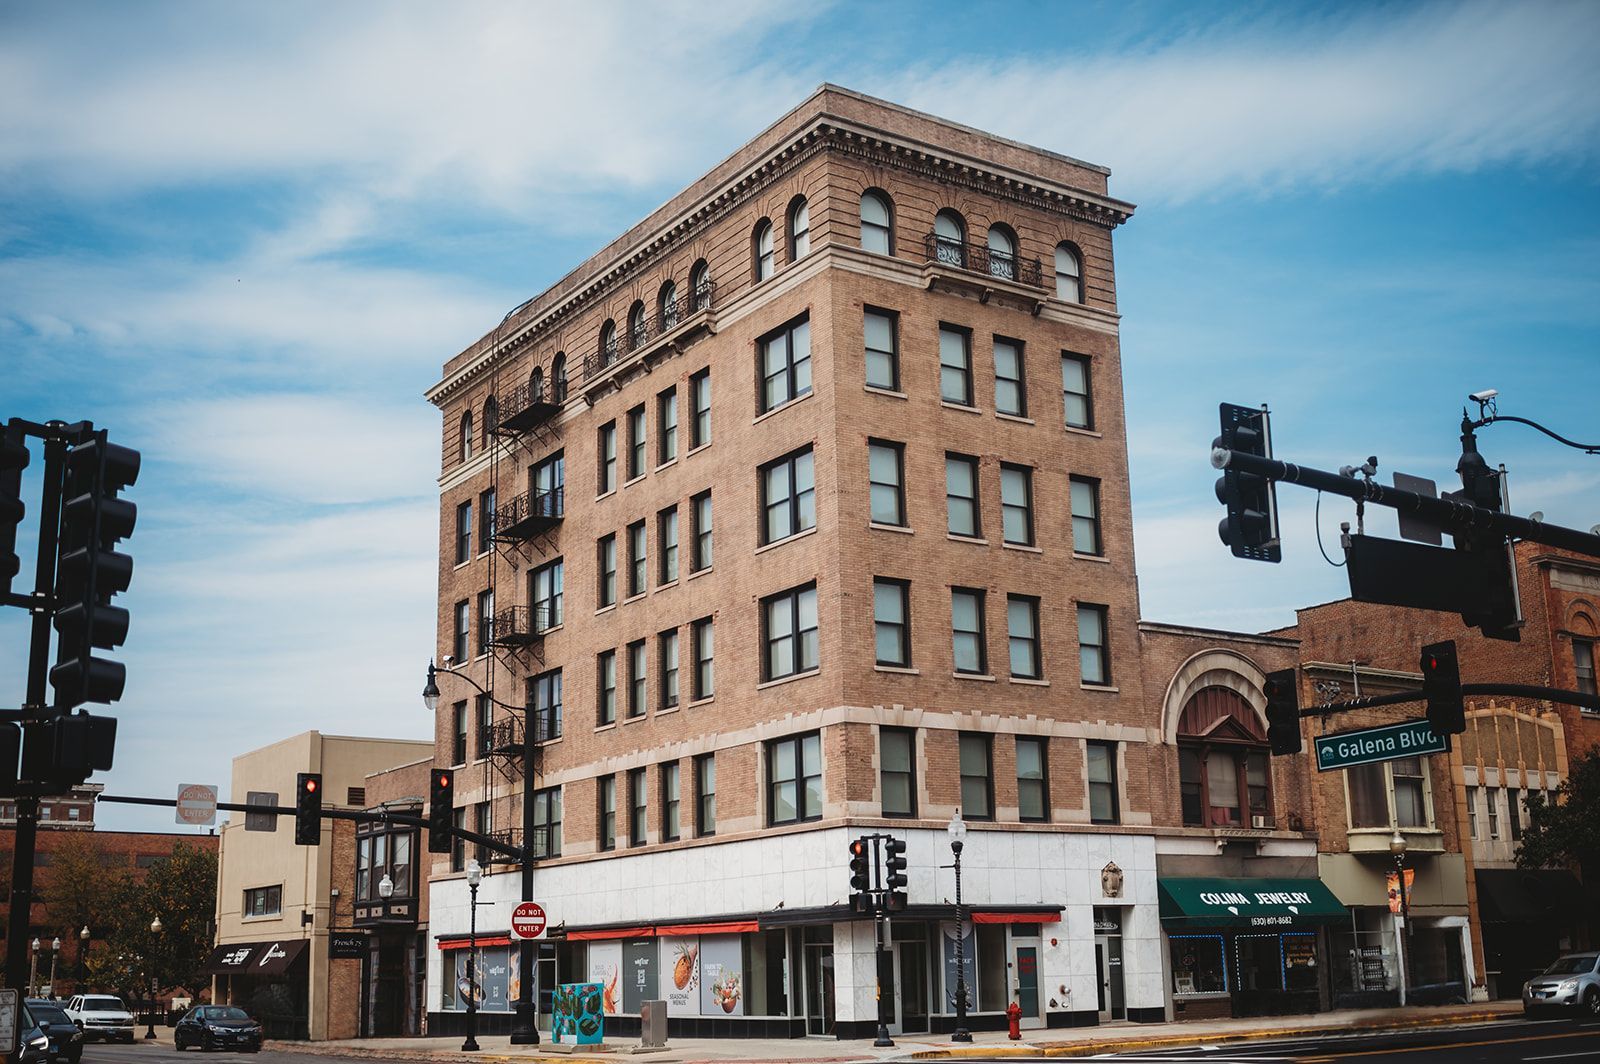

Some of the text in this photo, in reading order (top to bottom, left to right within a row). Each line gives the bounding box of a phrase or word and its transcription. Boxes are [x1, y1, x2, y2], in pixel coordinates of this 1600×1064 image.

[1338, 737, 1395, 758] Galena
[183, 791, 212, 800] DO NOT
[184, 809, 209, 817] ENTER
[1199, 892, 1312, 905] COLIMA JEWELRY
[333, 938, 354, 946] French
